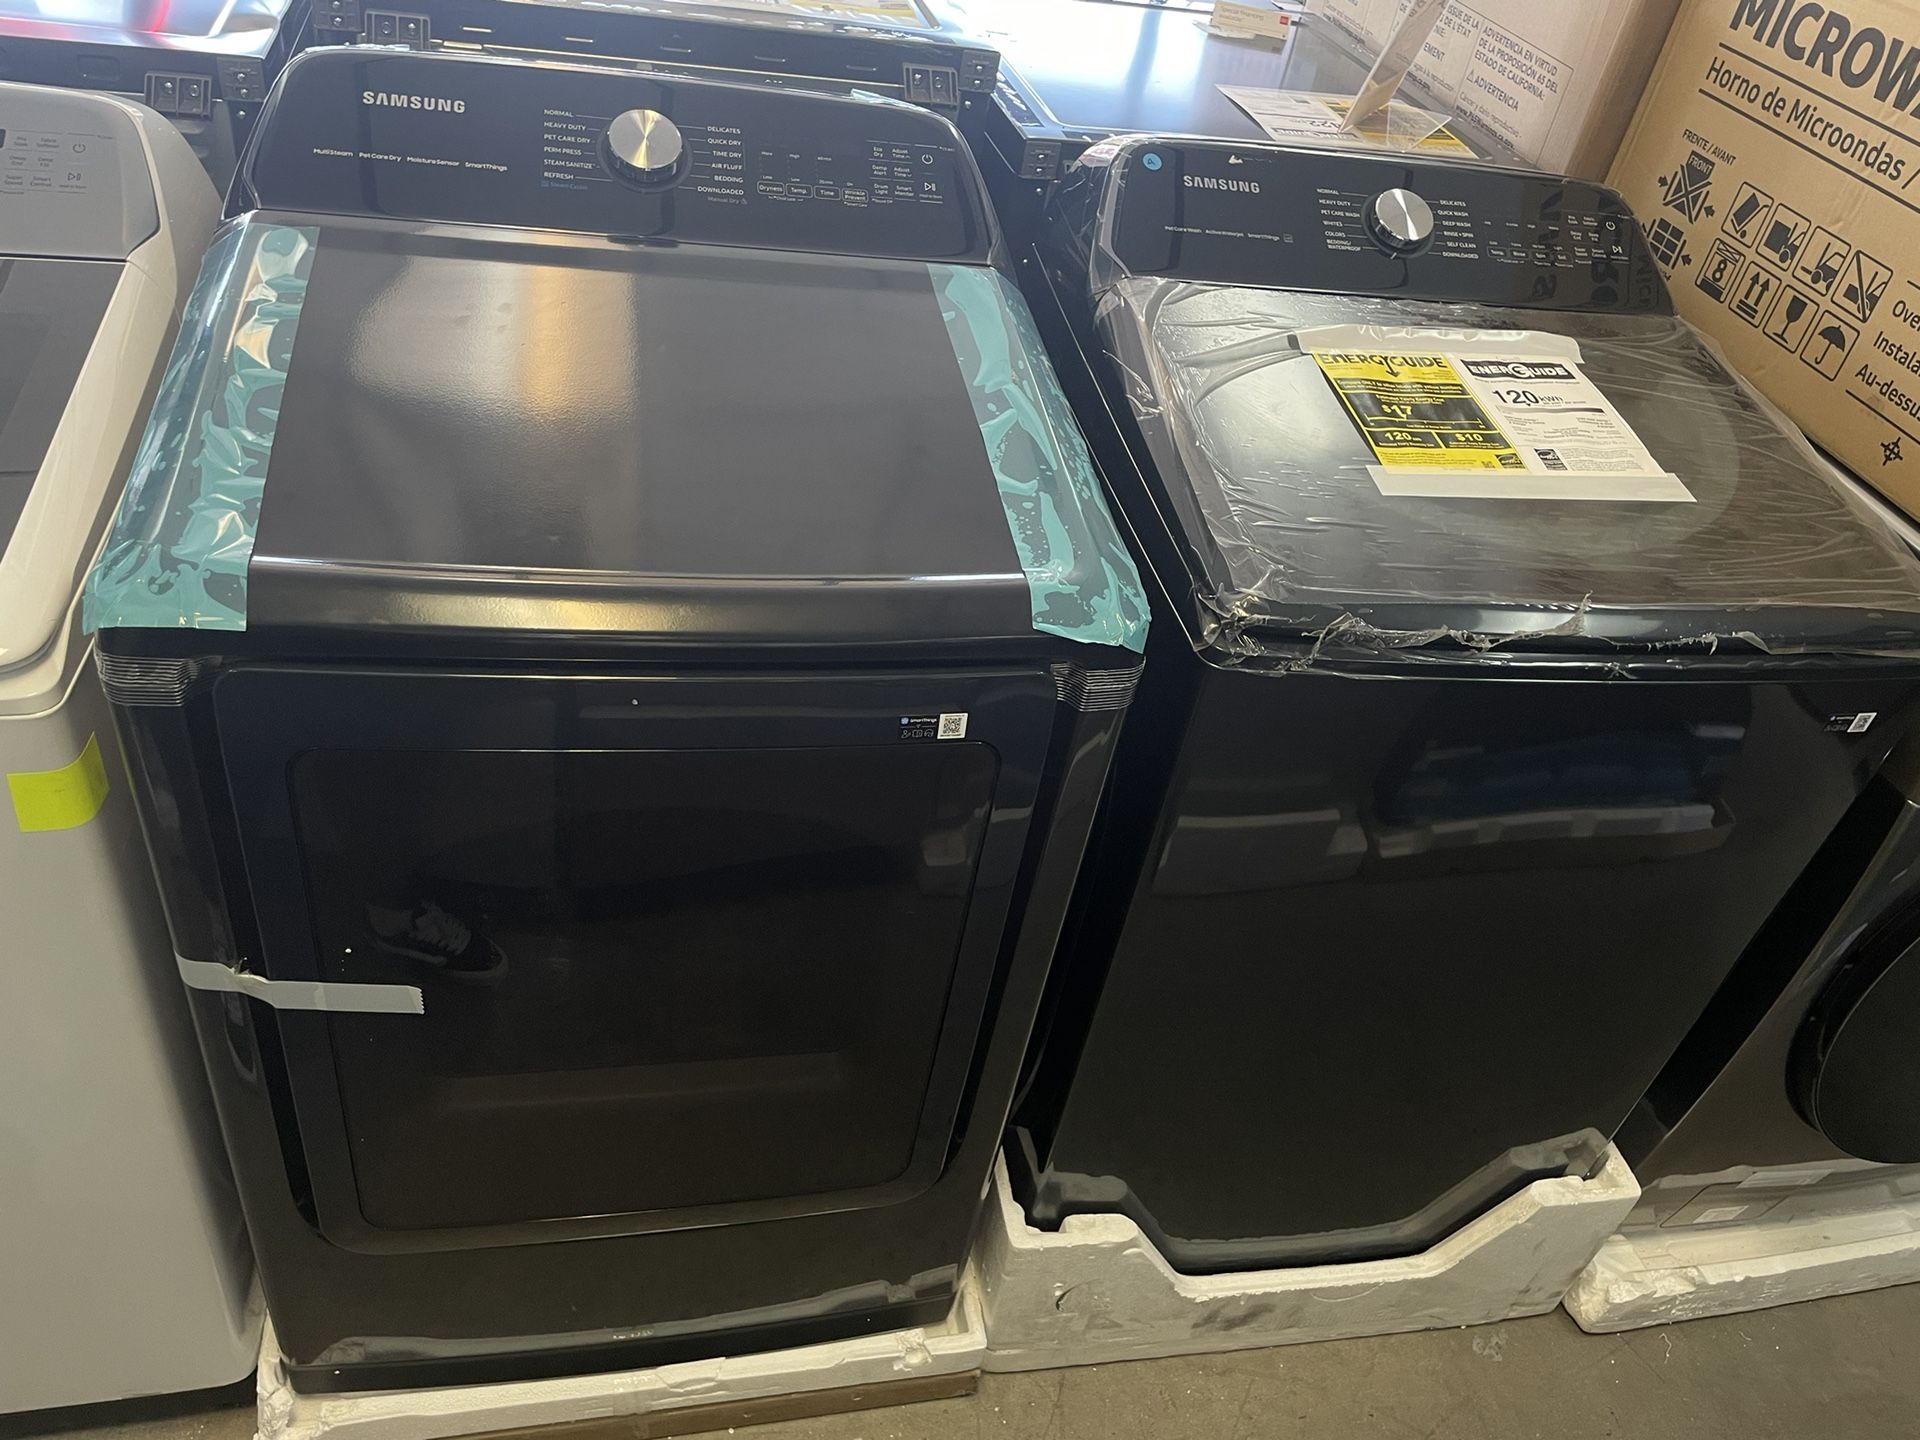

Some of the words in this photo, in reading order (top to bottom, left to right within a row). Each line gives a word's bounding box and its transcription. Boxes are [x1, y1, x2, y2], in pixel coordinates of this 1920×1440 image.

[1482, 26, 1524, 57] ADVERTENCIA
[1523, 49, 1534, 63] EN
[1534, 55, 1558, 77] VIRTUD
[1729, 0, 1920, 120] MICROW
[1478, 37, 1488, 51] DE
[1488, 43, 1496, 54] LA
[1495, 48, 1537, 82] PROPOSICIÓN
[1536, 73, 1546, 86] 65
[1545, 78, 1558, 94] DEL
[1474, 49, 1498, 71] ESTADO
[1498, 64, 1507, 77] DE
[1506, 70, 1546, 101] CALIFORNIA:
[362, 91, 466, 114] SAMSUNG
[1473, 76, 1520, 112] ADVERTENCIA
[543, 109, 574, 118] NORMAL
[1705, 56, 1761, 104] Horno
[1761, 86, 1788, 118] de
[1786, 98, 1907, 182] Microondas
[707, 126, 741, 134] DELICATES
[1682, 128, 1710, 151] FRENTE
[1711, 146, 1737, 166] AVANT
[1688, 155, 1713, 176] FRONT
[543, 172, 574, 180] REFRESH
[713, 175, 744, 183] BEDDING
[1183, 175, 1261, 194] SAMSUNG
[697, 185, 744, 195] DOWNLOADED
[759, 184, 783, 192] Dryness
[1439, 199, 1467, 207] DELICATES
[1442, 251, 1479, 259] DOWNLOADED
[1872, 330, 1920, 377] Instala
[1468, 362, 1571, 380] ENERGUIDE
[1492, 389, 1540, 405] 120
[1539, 395, 1564, 403] kWh
[1381, 404, 1413, 417] $17
[1384, 432, 1411, 441] 120
[1455, 433, 1484, 442] $10
